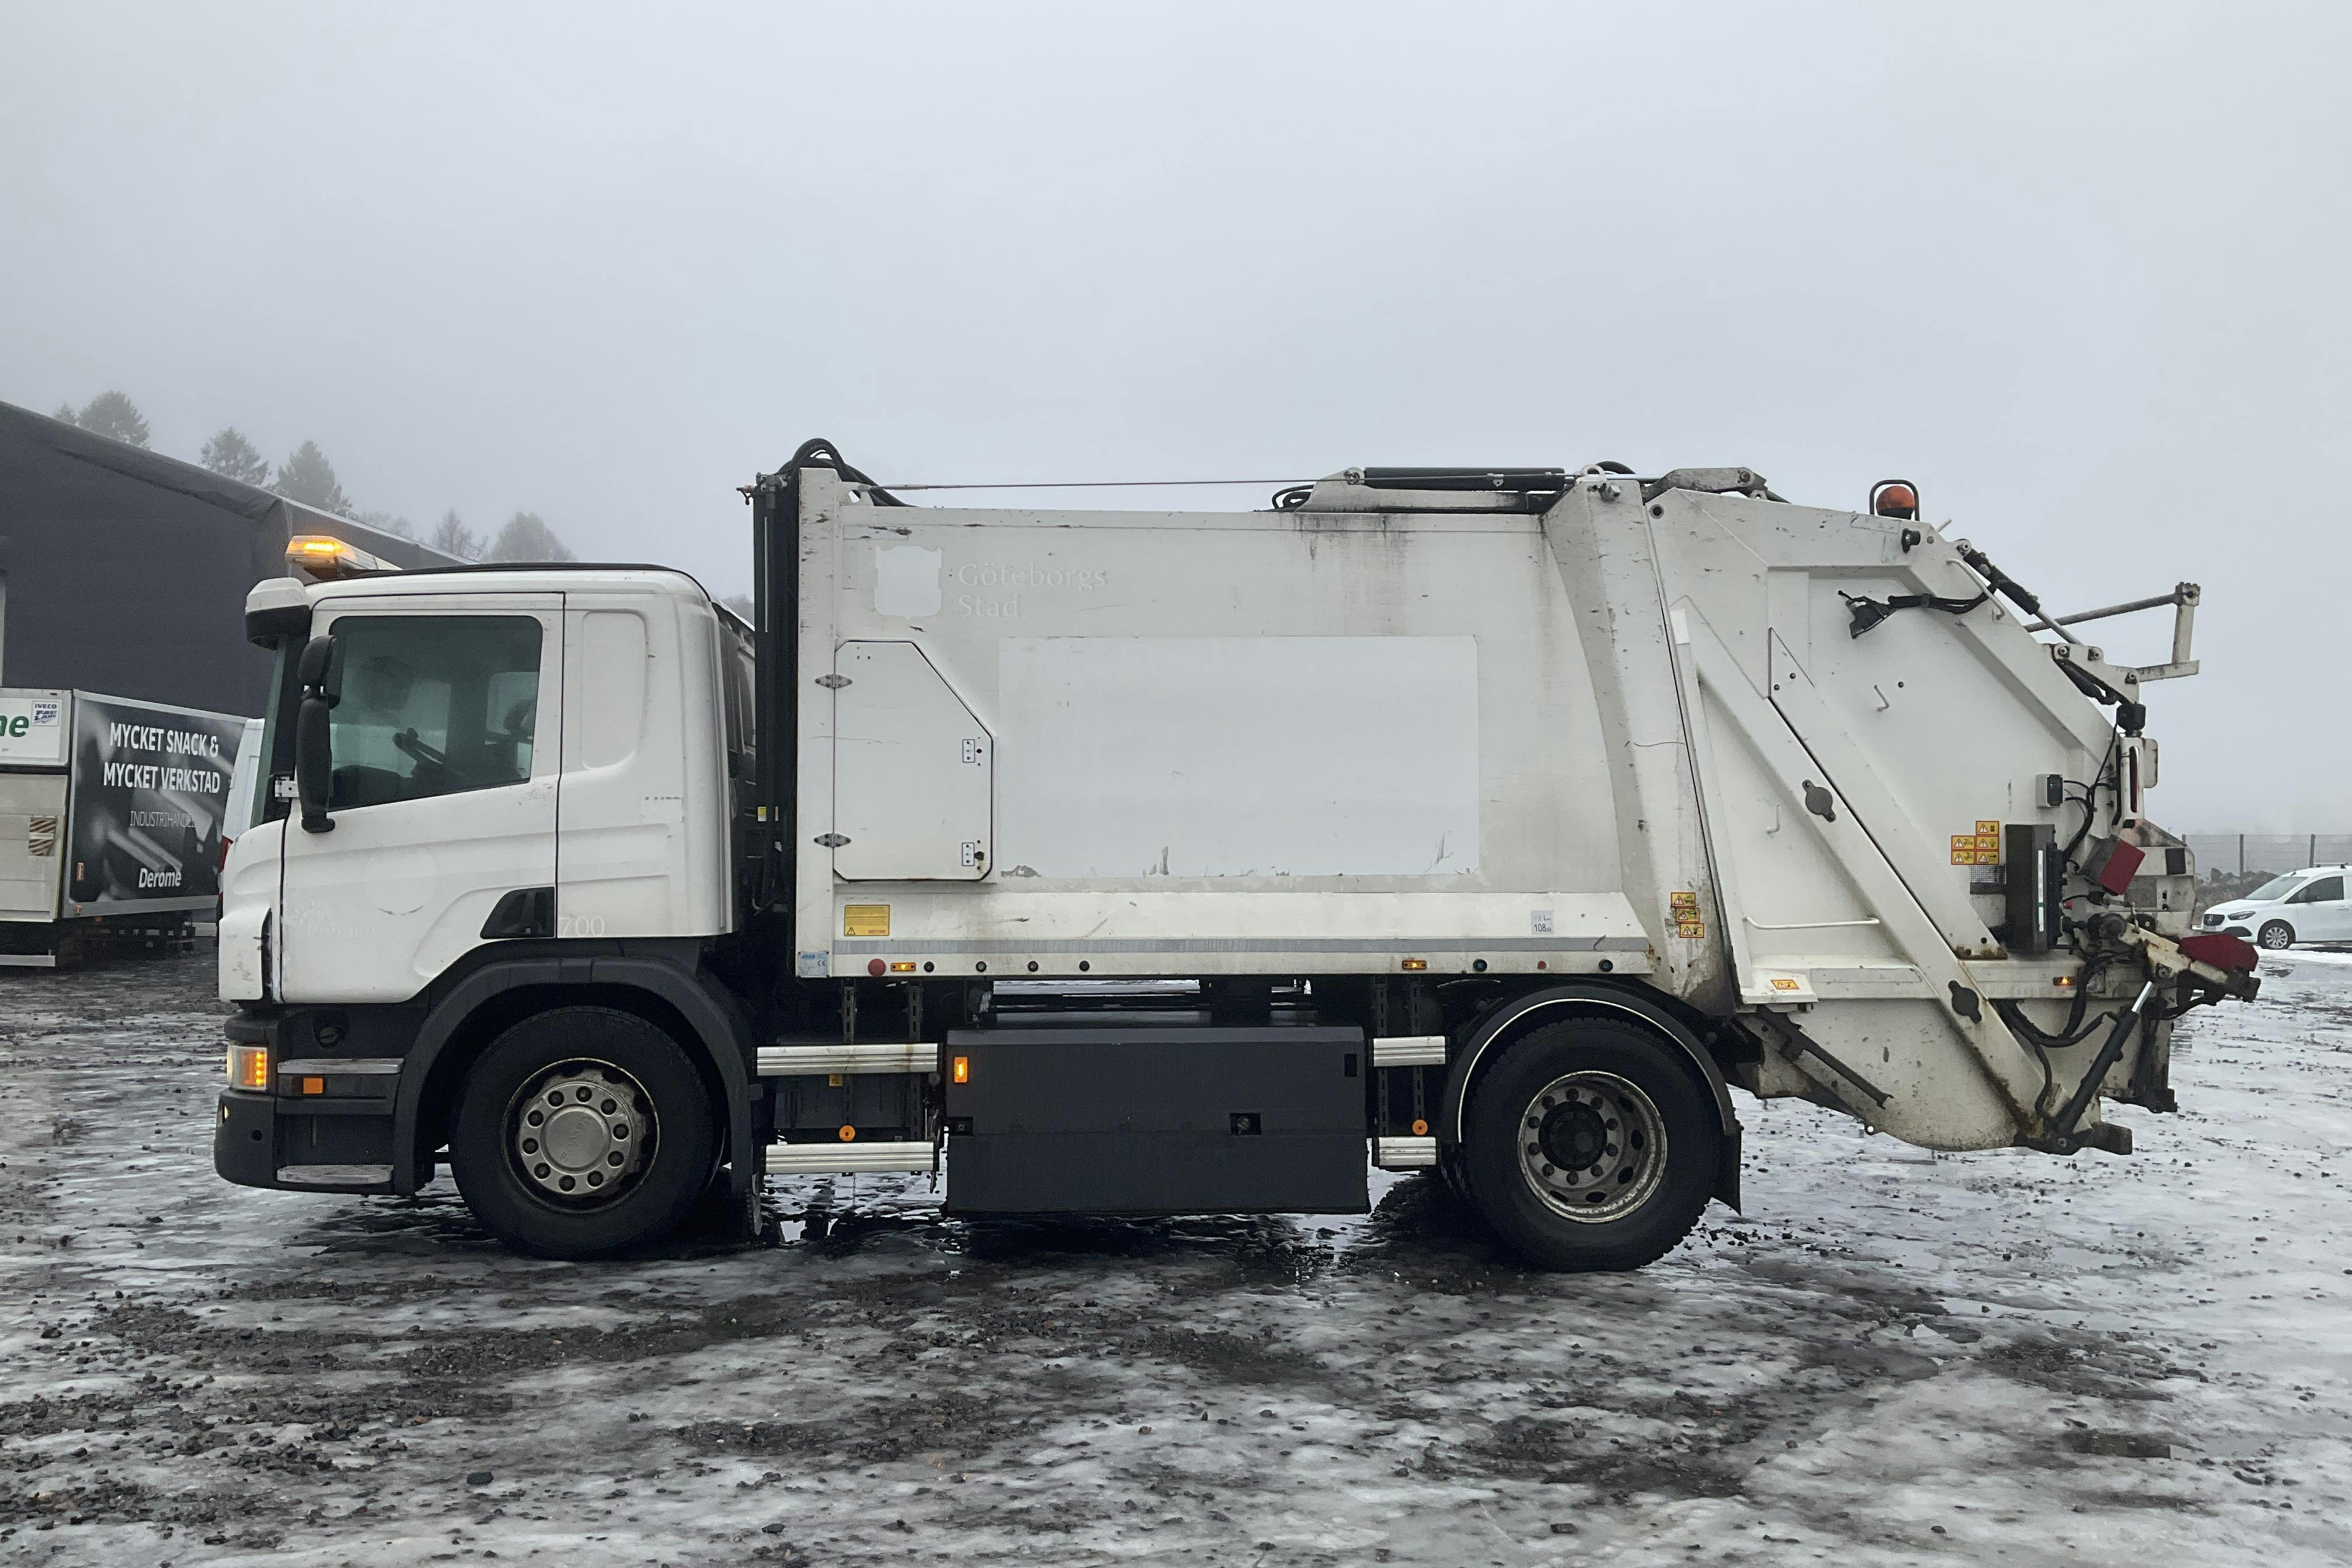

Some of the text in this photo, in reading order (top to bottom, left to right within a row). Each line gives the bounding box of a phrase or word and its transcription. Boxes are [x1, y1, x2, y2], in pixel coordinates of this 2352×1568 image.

[958, 562, 1107, 593] Göteborgs
[958, 593, 1020, 617] Stad
[110, 722, 219, 758] MYCKET SNACK &
[103, 762, 220, 793] MYCKET VERKSTAD
[138, 867, 181, 888] Derome
